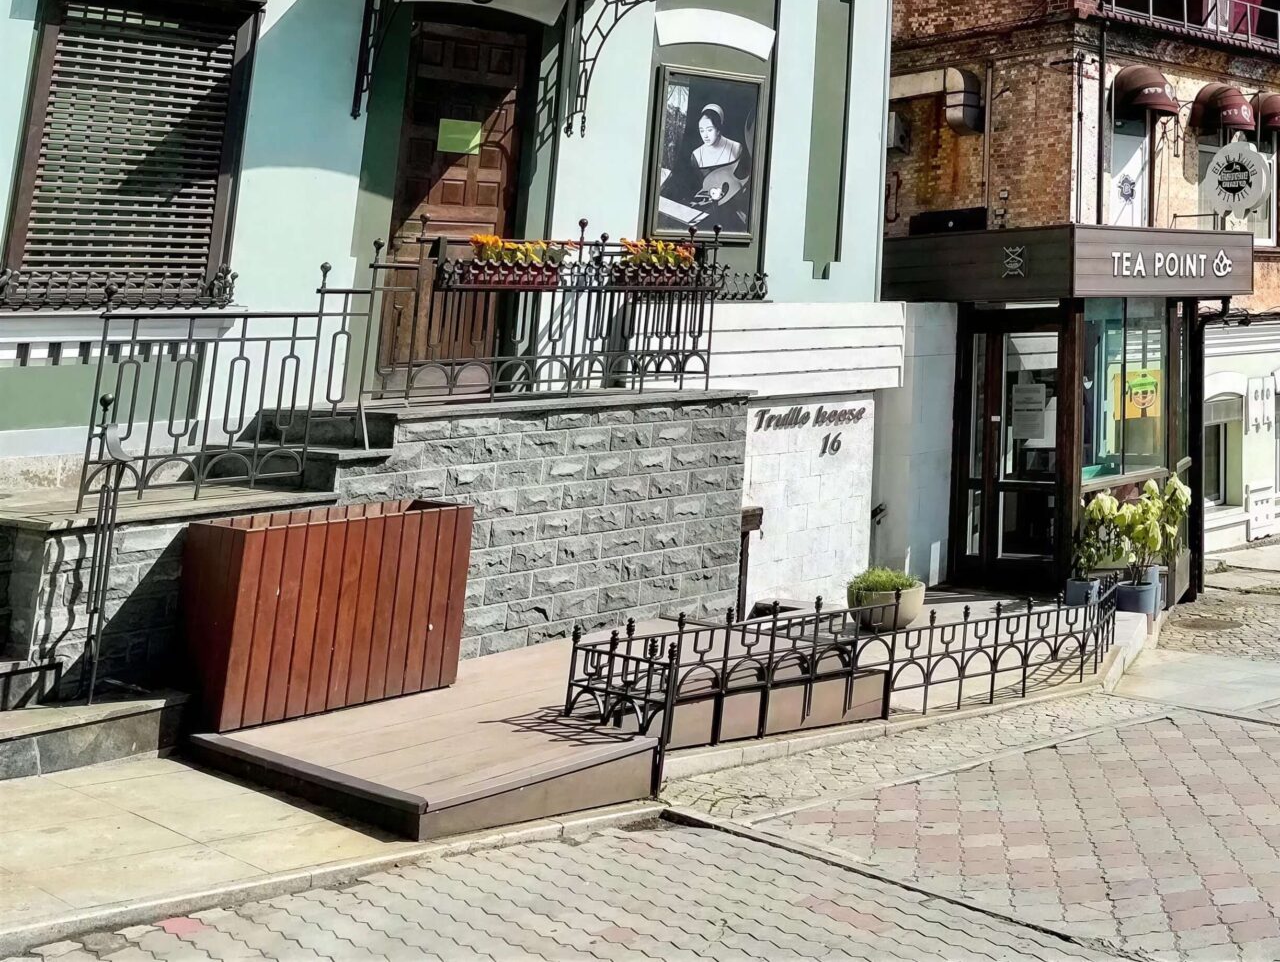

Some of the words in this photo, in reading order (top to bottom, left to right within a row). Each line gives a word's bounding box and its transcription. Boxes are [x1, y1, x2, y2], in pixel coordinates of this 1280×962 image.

[1111, 251, 1147, 278] TEA
[1153, 251, 1207, 279] POINT
[819, 432, 842, 457] 16
